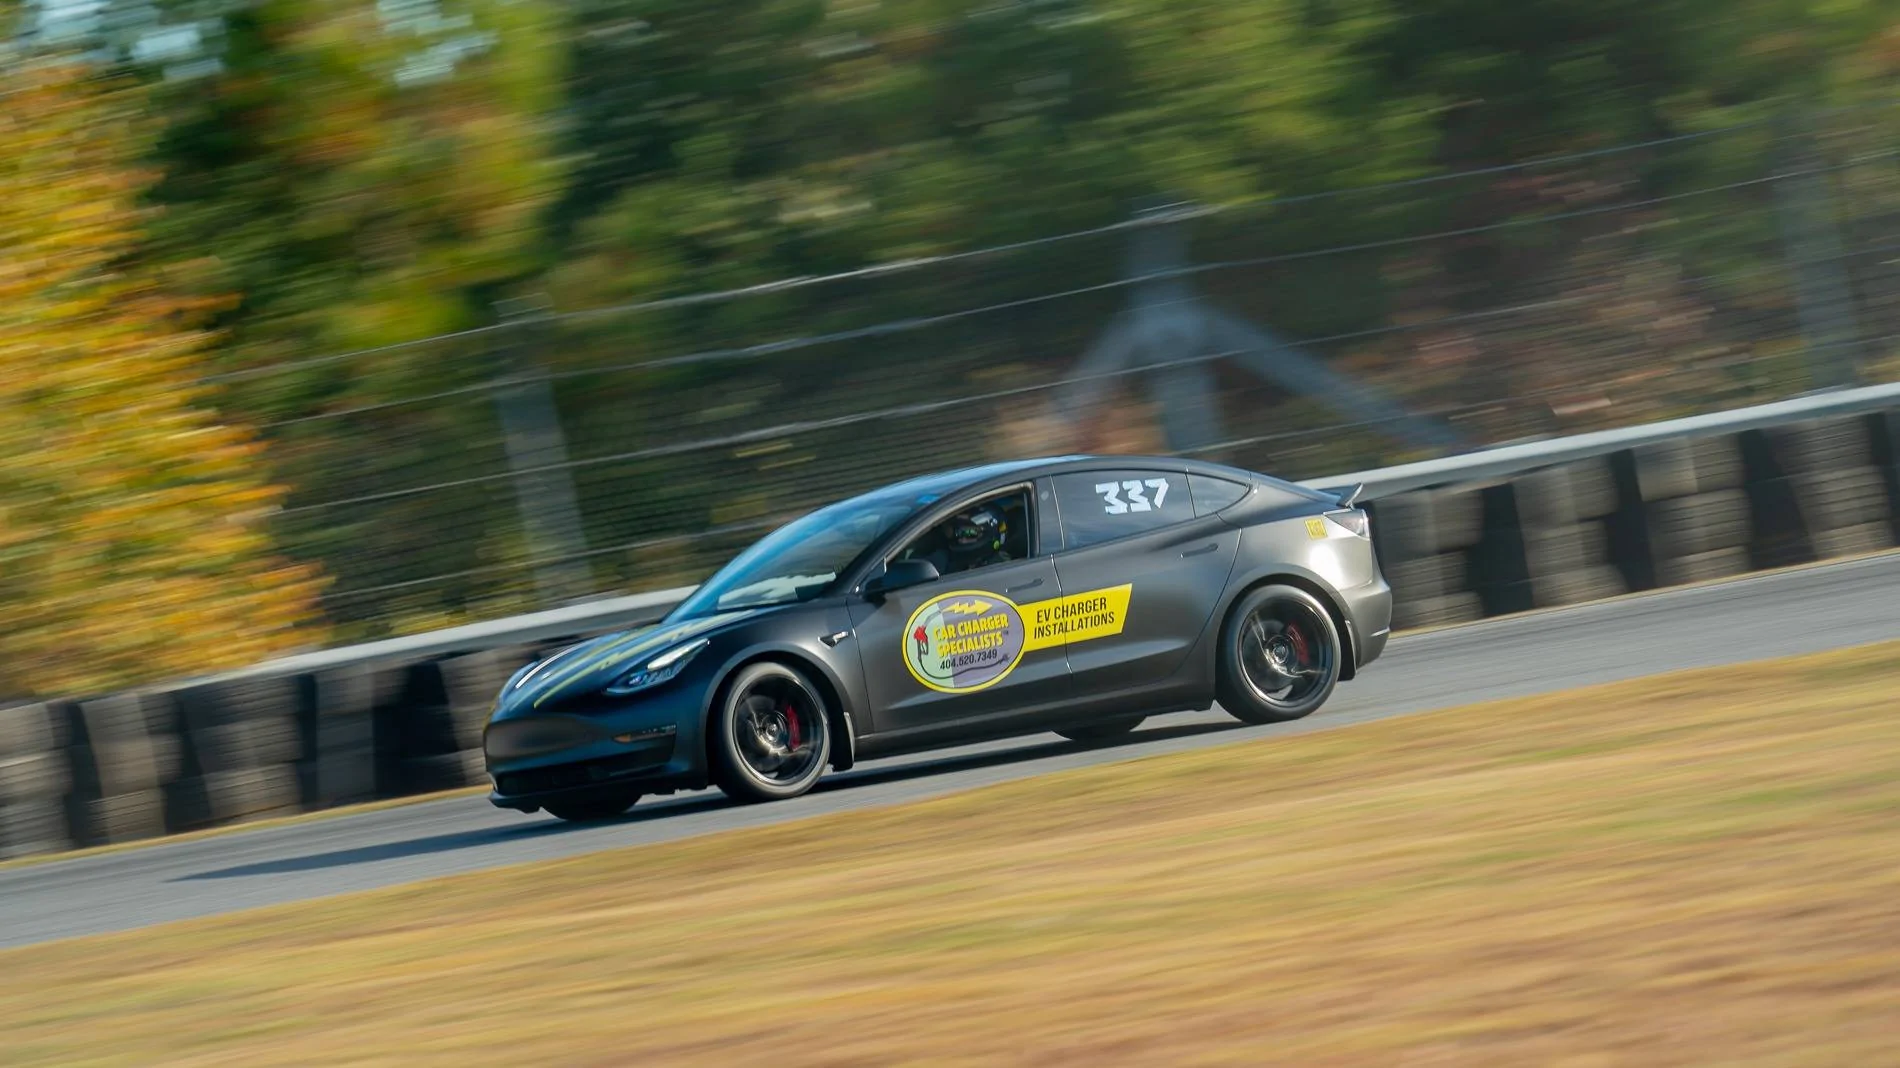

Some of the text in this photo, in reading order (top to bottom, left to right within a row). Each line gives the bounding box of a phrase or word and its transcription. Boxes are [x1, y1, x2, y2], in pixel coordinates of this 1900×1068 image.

[1095, 478, 1169, 515] 337
[1036, 597, 1107, 623] EV CHARGER
[933, 614, 1009, 641] CAR CHARGER
[1033, 611, 1115, 639] INSTALLATIONS
[936, 631, 1004, 658] SPECIALISTS
